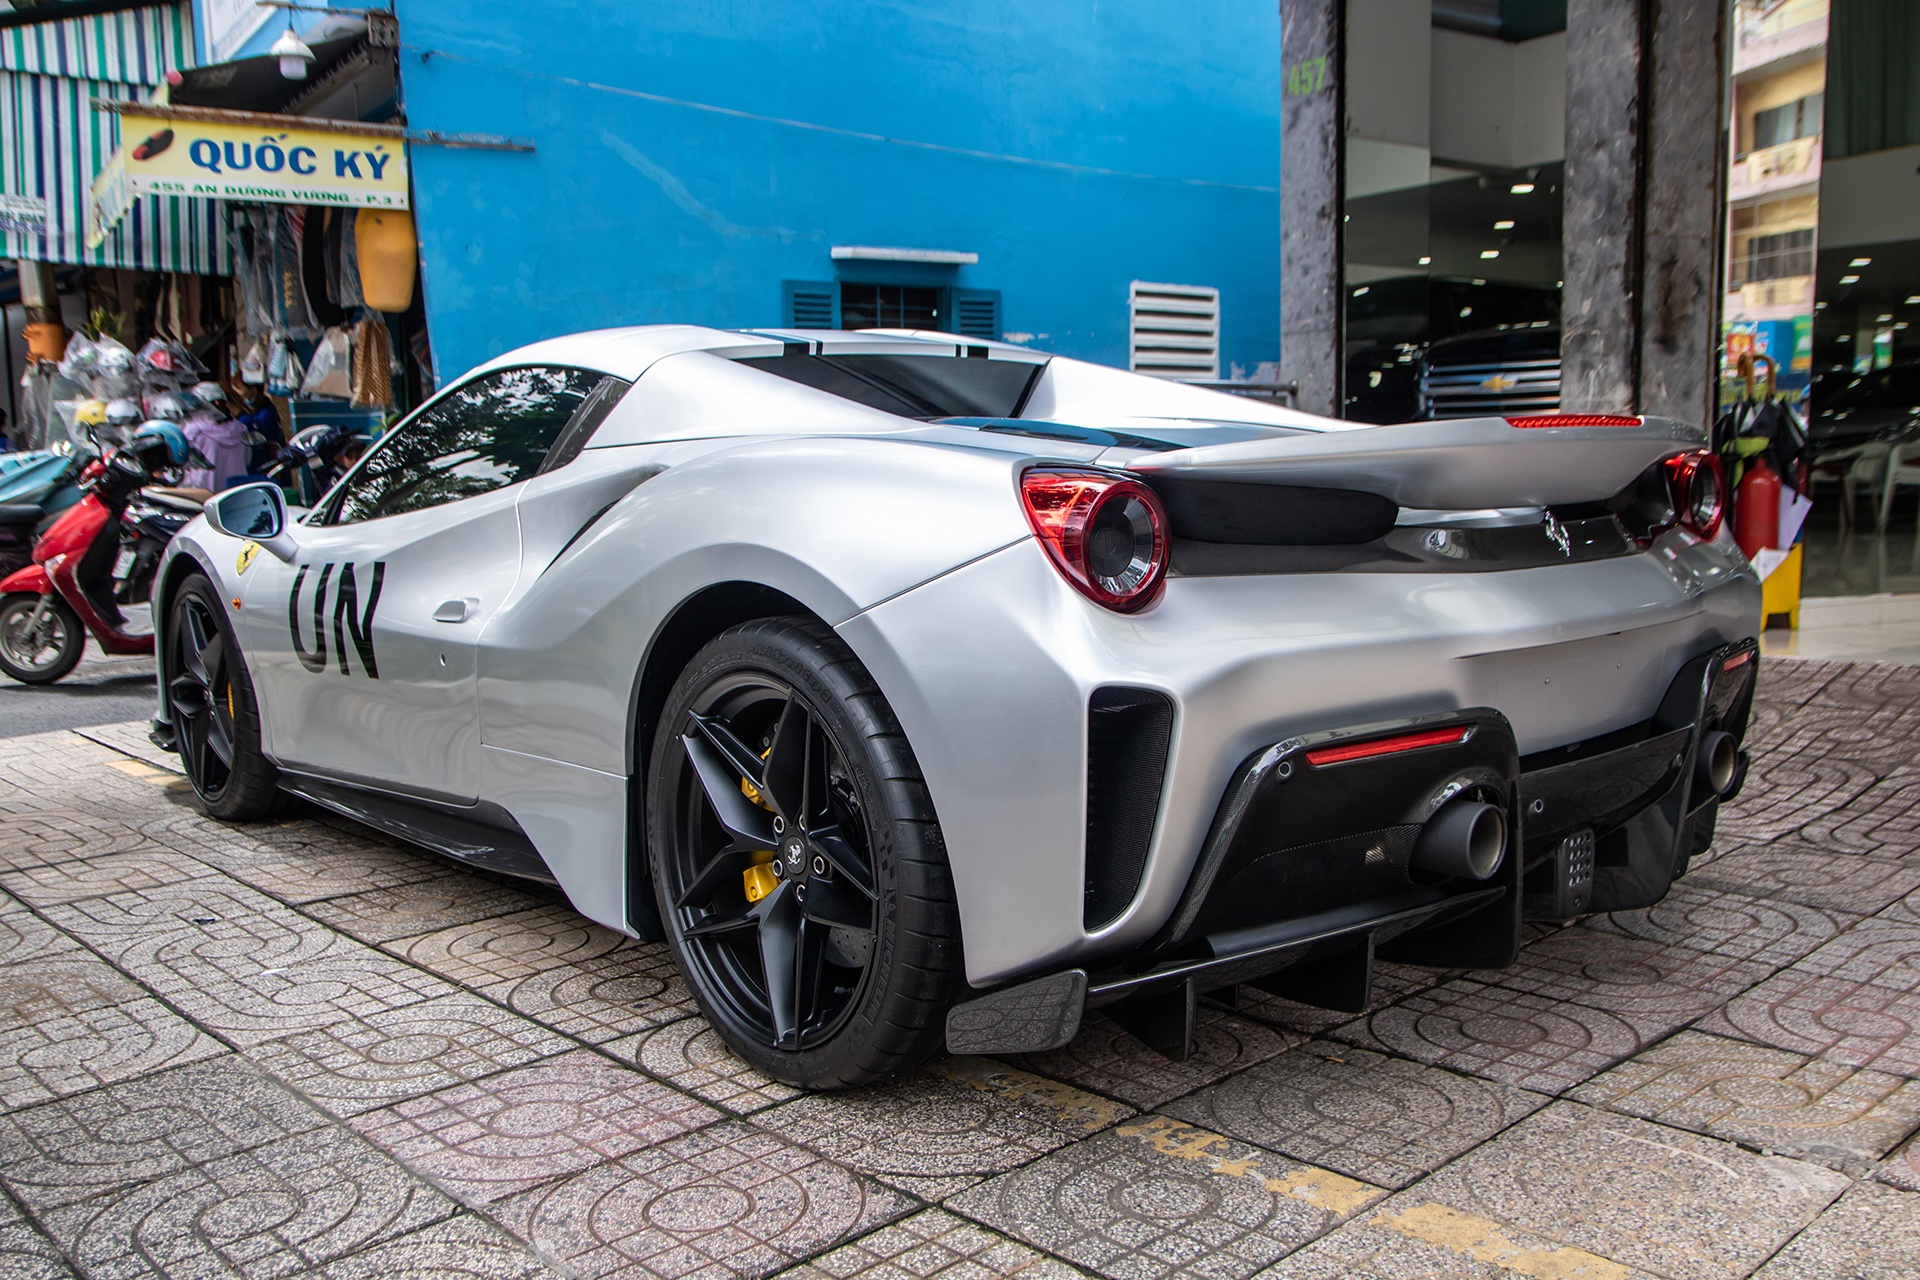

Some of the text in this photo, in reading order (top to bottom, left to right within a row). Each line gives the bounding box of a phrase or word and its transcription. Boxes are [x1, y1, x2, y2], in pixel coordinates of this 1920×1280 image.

[1288, 55, 1326, 96] 457
[189, 133, 390, 181] QUỐC KÝ
[149, 181, 185, 193] 455
[193, 184, 217, 194] AN
[289, 562, 386, 679] UN
[864, 918, 896, 1025] MICHELIN
